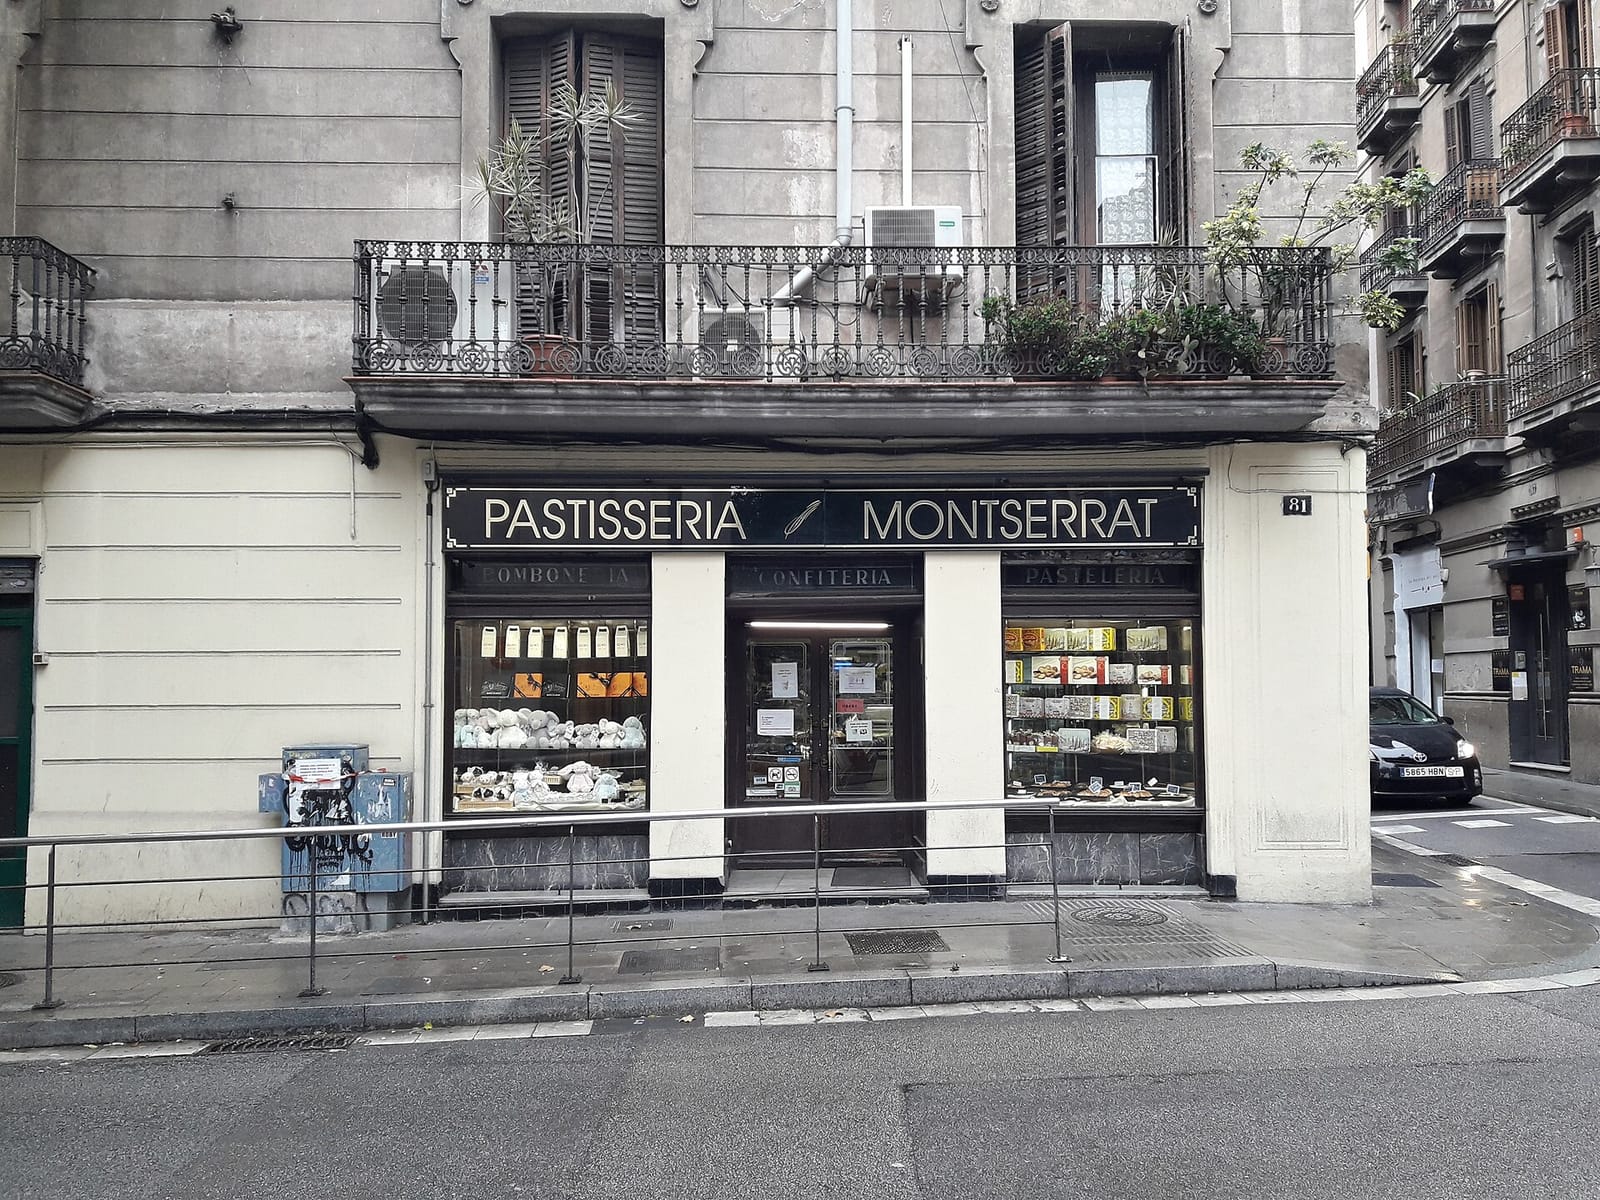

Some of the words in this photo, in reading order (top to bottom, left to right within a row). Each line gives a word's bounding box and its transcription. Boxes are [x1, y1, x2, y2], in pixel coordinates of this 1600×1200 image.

[1289, 497, 1307, 513] 81
[485, 498, 747, 540] PASTISSERIA
[863, 498, 1158, 540] MONTSERRAT
[758, 568, 892, 586] CONFITERIA
[1025, 567, 1166, 585] PASTELERIA
[1493, 667, 1510, 675] TRAMA
[1571, 665, 1592, 674] TRAMA
[1405, 767, 1426, 776] 5865
[1428, 767, 1444, 776] HBN
